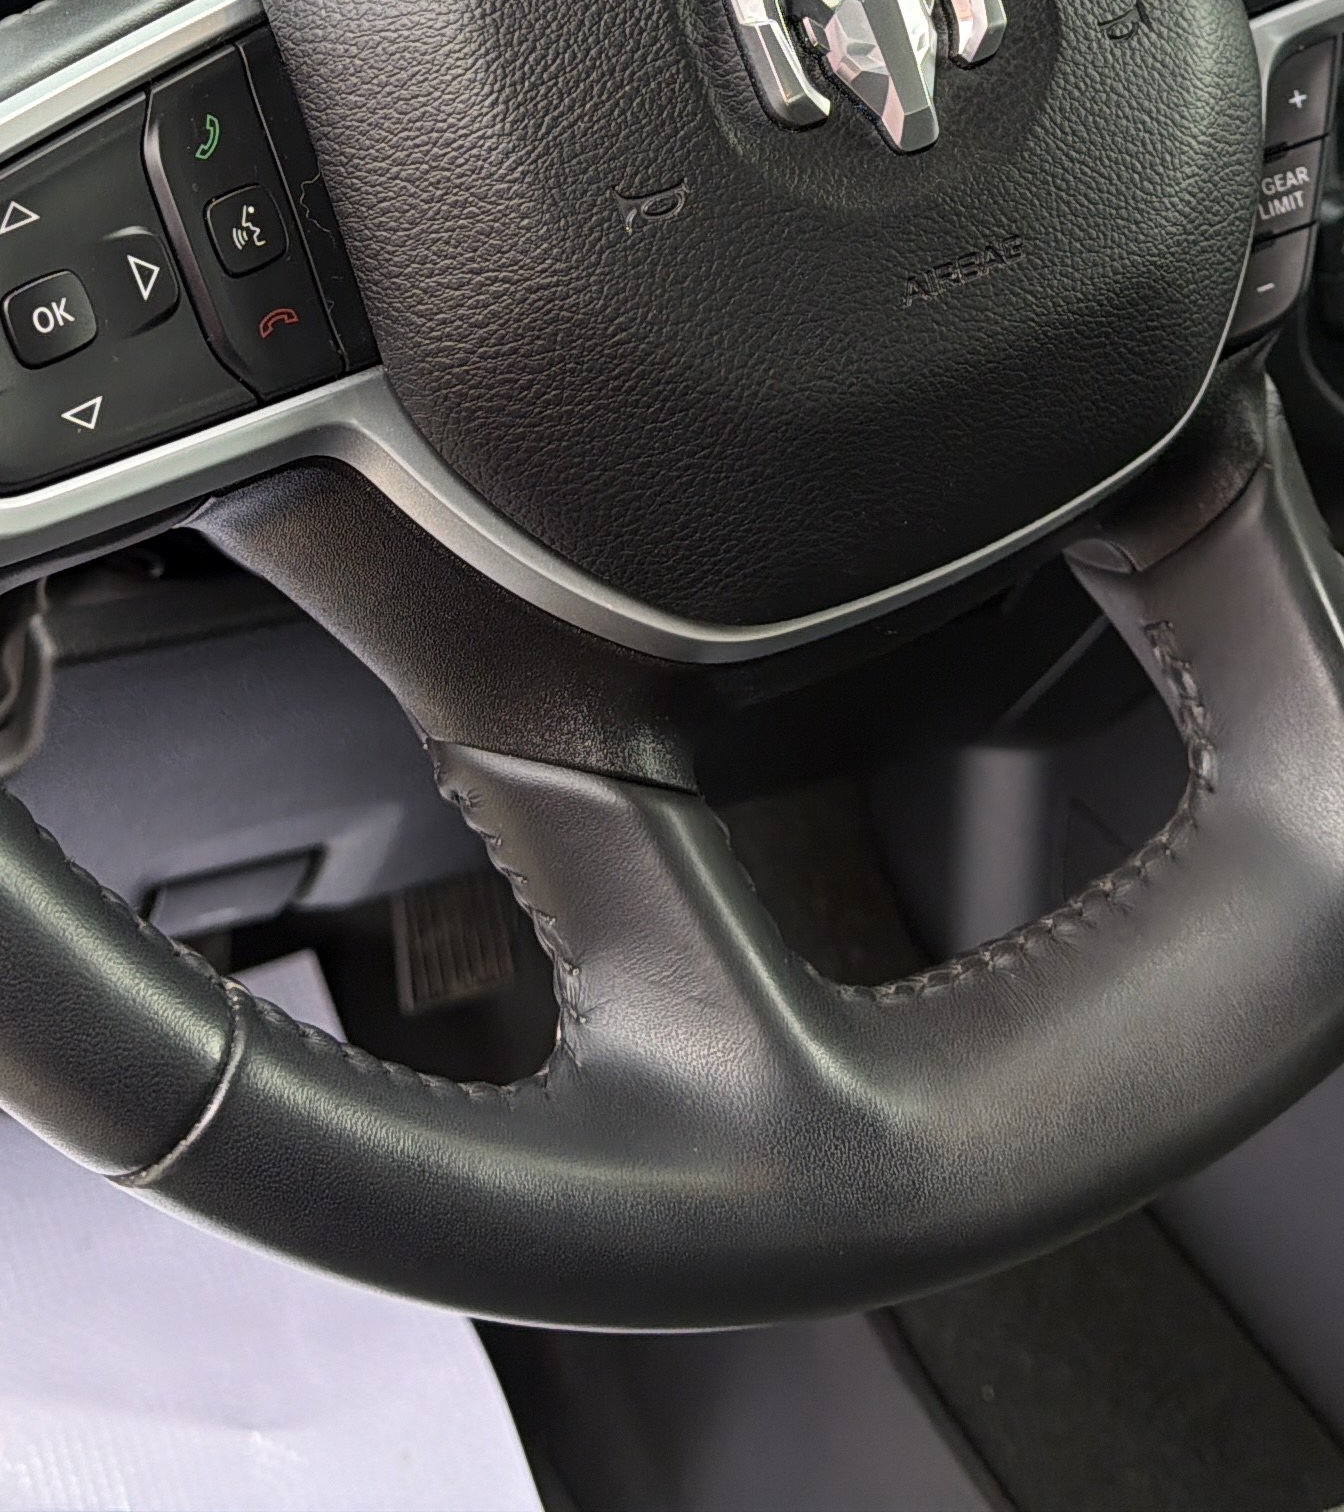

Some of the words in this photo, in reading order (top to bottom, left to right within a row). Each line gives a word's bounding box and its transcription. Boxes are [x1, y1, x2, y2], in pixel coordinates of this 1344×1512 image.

[1261, 166, 1310, 196] GEAR
[1257, 190, 1306, 220] LIMIT
[903, 233, 1024, 308] AIRBAG
[32, 296, 76, 334] OK
